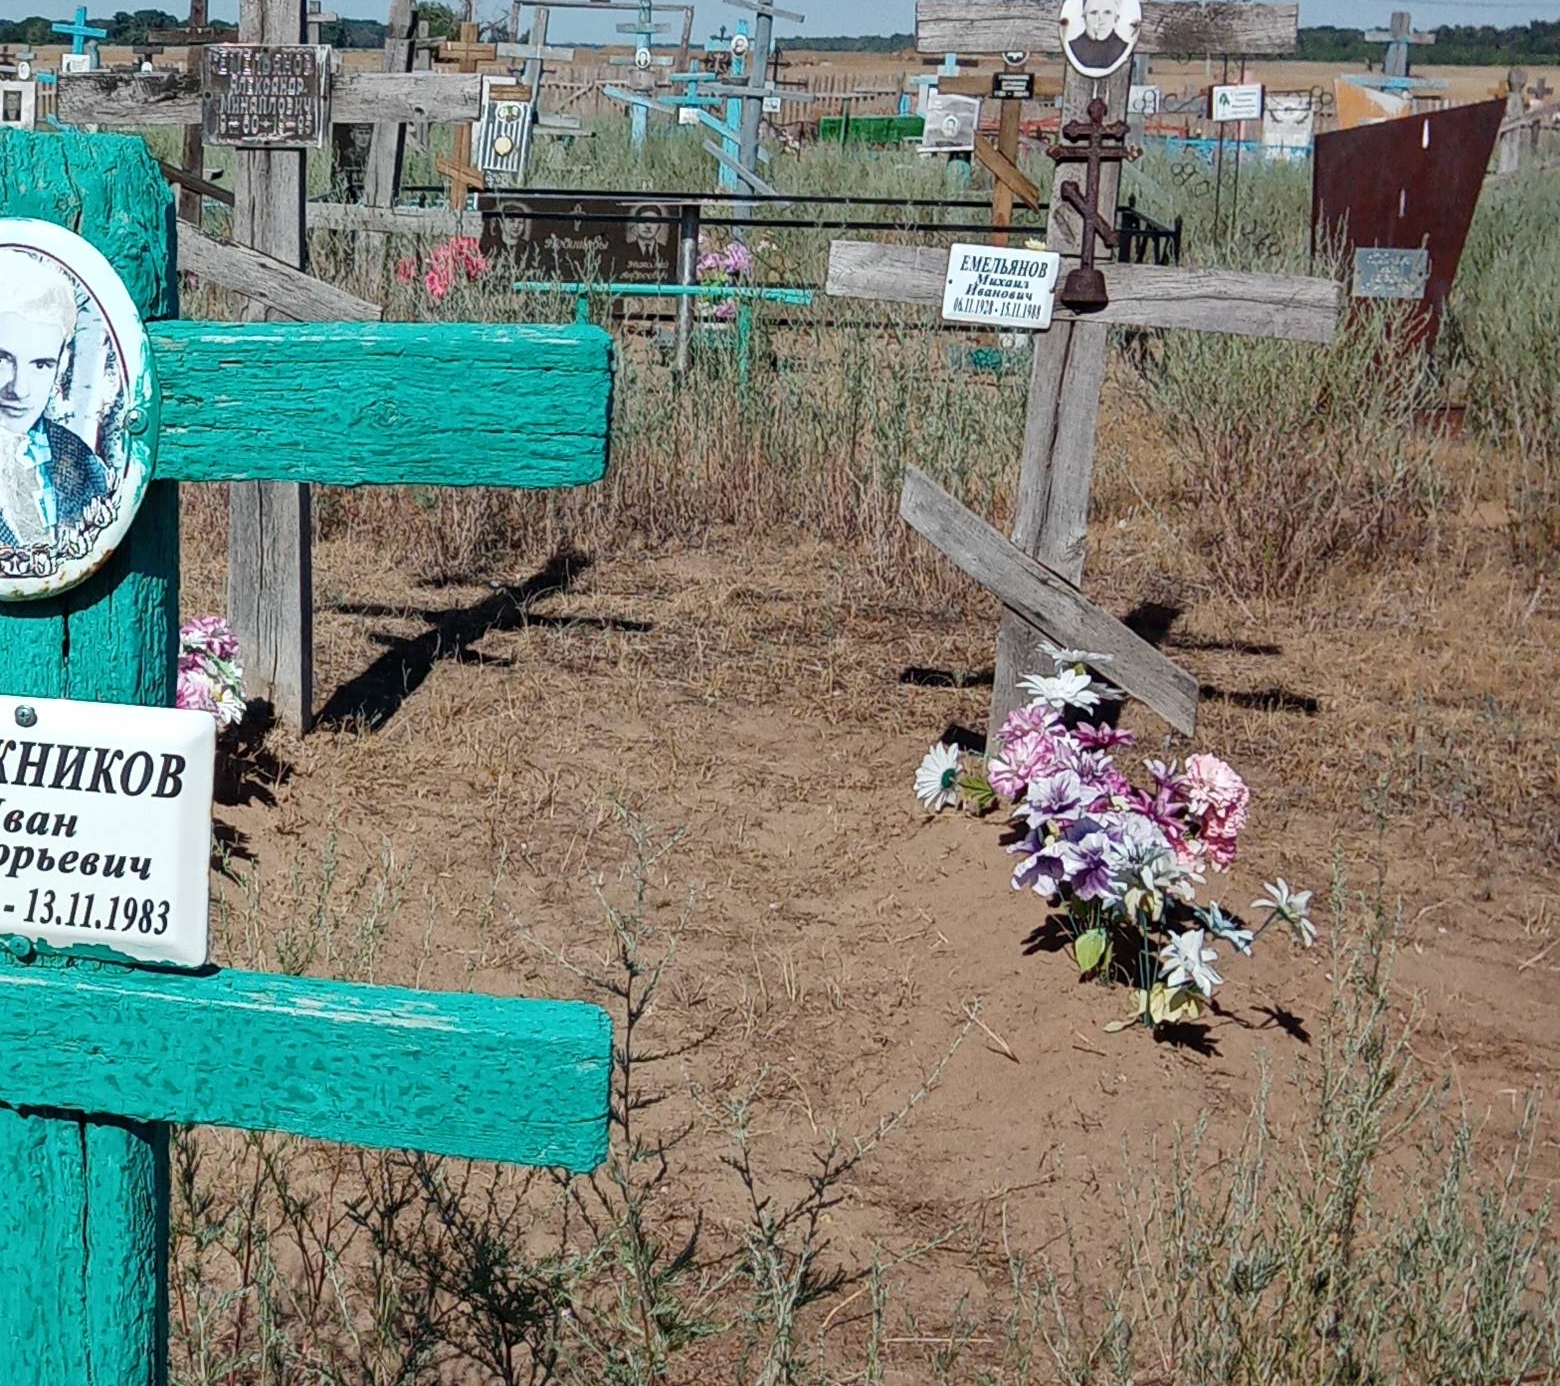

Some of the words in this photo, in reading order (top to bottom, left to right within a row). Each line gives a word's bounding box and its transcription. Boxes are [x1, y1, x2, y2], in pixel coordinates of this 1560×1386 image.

[960, 254, 1048, 278] ЕМЕЛЬЯНОВ
[965, 281, 1033, 301] Иванович
[976, 273, 1029, 289] Михаил
[23, 887, 171, 936] 13.11.1983
